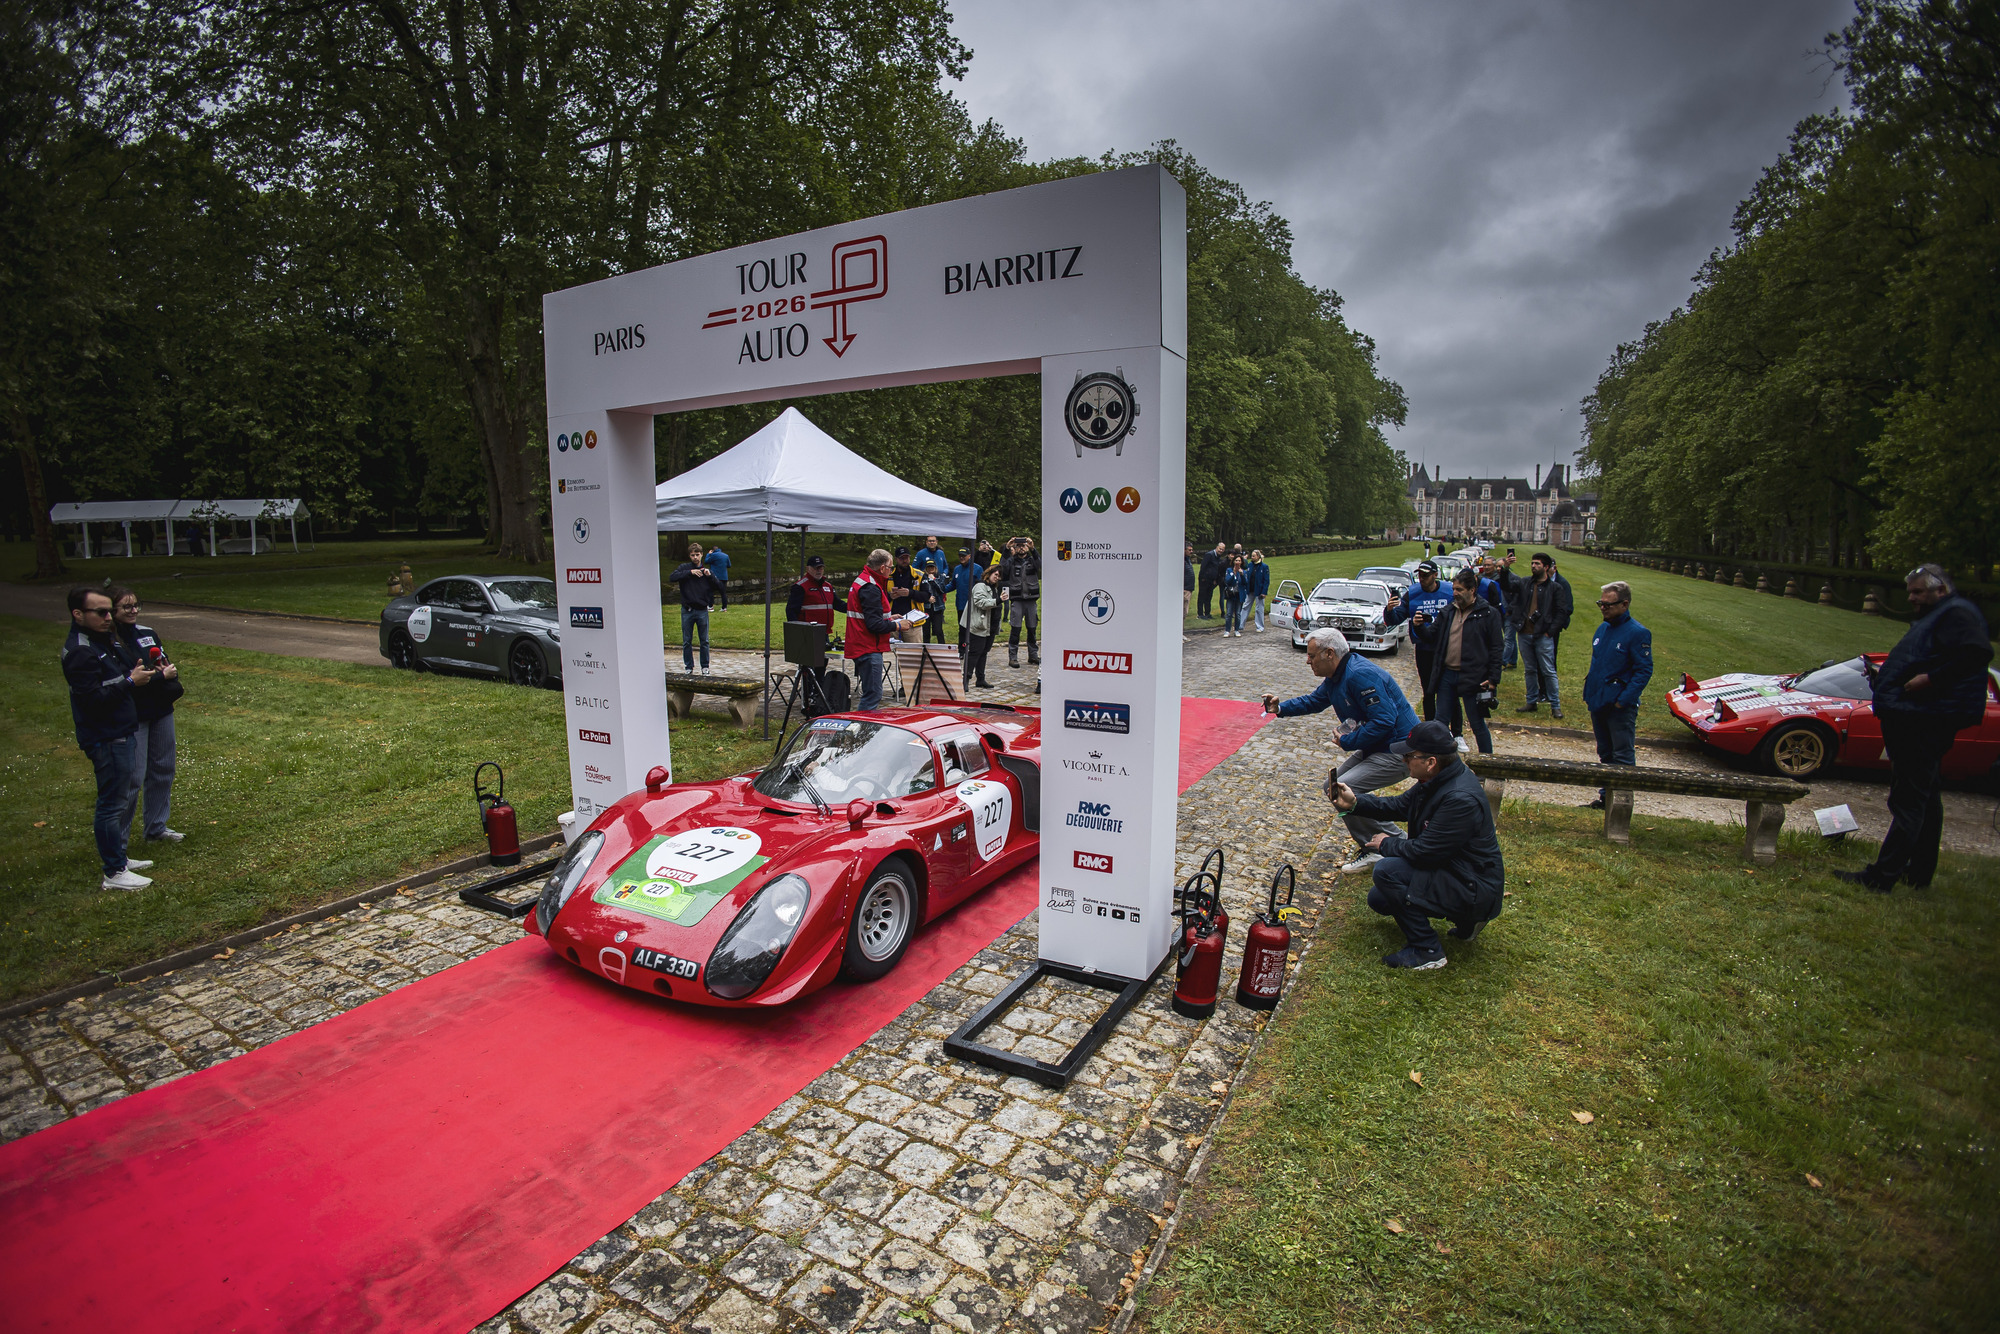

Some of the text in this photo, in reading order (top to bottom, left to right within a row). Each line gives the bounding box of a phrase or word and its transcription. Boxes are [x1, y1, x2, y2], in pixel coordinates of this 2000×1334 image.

[736, 252, 807, 296] TOUR
[944, 245, 1083, 295] BIARRITZ
[741, 295, 806, 322] 2026
[594, 324, 645, 356] PARIS
[738, 323, 809, 365] AUTO
[1075, 541, 1112, 550] EDMOND
[1075, 551, 1143, 561] DE ROTHSCHILD
[568, 570, 600, 583] MOTUL
[571, 613, 602, 623] AXIAL
[572, 659, 600, 669] VICOMTE
[1066, 653, 1129, 671] MOTUL
[575, 695, 610, 710] BALTIC
[1066, 708, 1127, 726] AXIAL
[813, 721, 846, 730] AXIAL
[1066, 721, 1128, 731] PROFESSION CARROSSIER
[581, 730, 609, 743] Le Point
[1062, 759, 1130, 777] VICOMTE A.
[584, 771, 612, 783] TOURISME
[984, 797, 1004, 829] 227
[1078, 800, 1111, 817] RMC
[674, 842, 735, 862] 227
[986, 836, 1002, 855] MOTUL
[1077, 854, 1109, 870] RMC
[657, 867, 694, 882] MOTUL
[646, 883, 670, 896] 227
[1052, 888, 1073, 898] PETER
[632, 892, 658, 903] EDMOND
[1046, 899, 1077, 908] auto
[634, 899, 673, 914] ROTHSCHILD
[634, 949, 697, 978] ALF 33D
